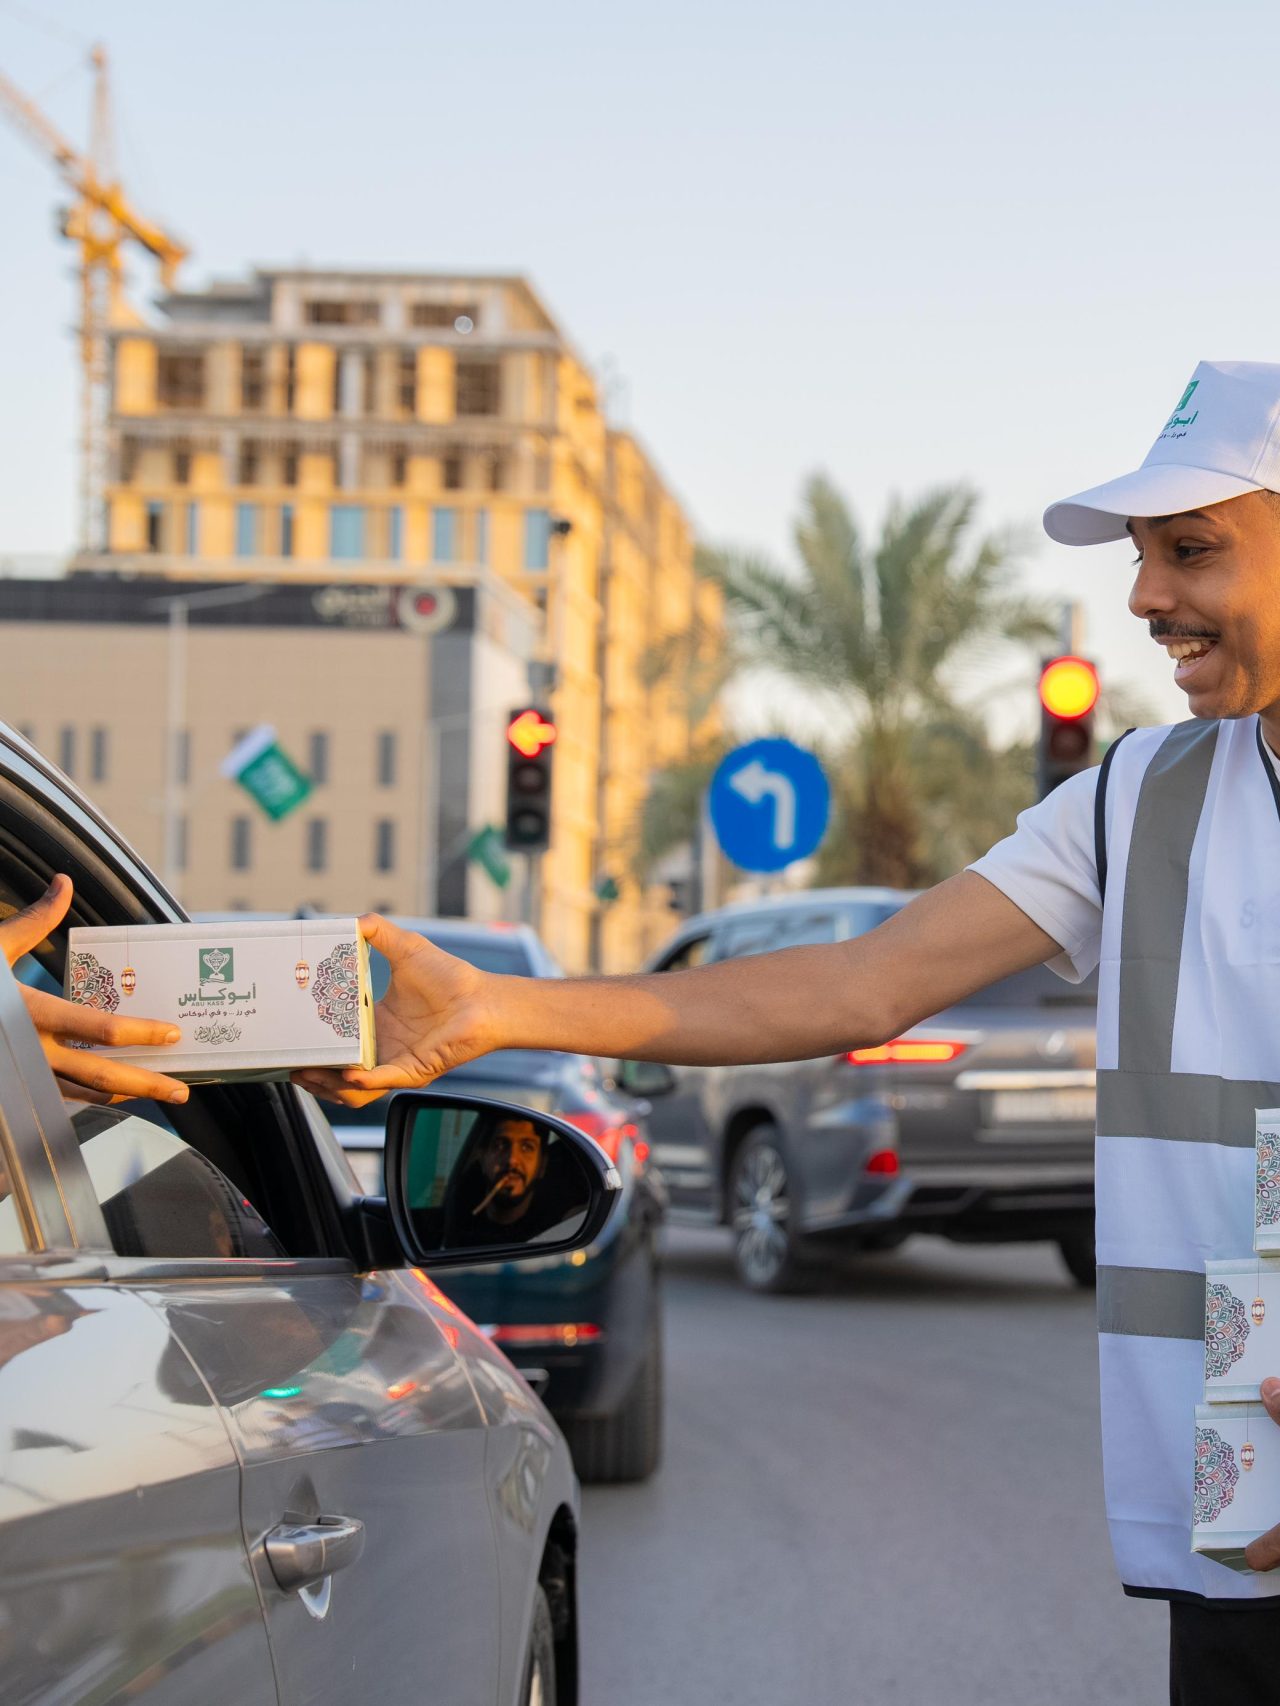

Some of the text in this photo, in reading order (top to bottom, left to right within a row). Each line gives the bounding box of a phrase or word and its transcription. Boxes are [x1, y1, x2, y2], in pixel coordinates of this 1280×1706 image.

[178, 982, 257, 1007] أبوكاس
[208, 1008, 221, 1018] في
[244, 1008, 257, 1017] في
